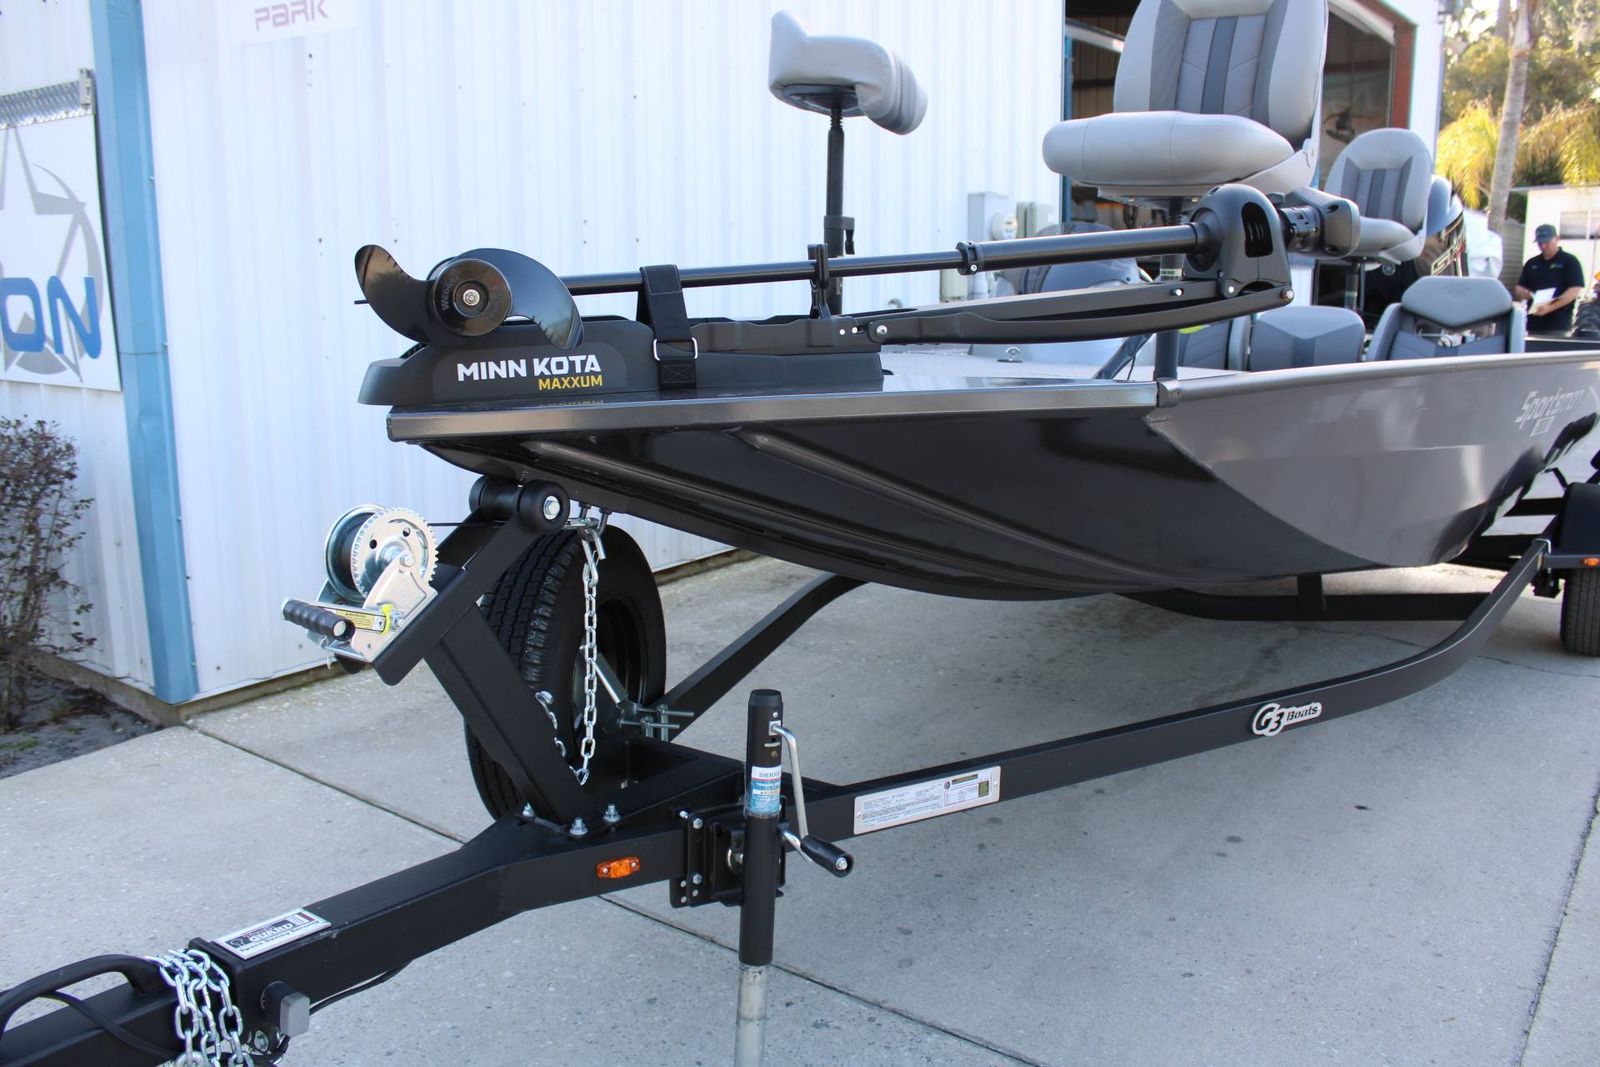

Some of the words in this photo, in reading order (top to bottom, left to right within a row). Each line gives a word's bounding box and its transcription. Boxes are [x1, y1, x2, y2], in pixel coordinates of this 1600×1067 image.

[457, 359, 527, 382] MINN
[533, 354, 602, 377] KOTA
[538, 374, 604, 391] MAXXUM
[1286, 706, 1318, 721] Boats
